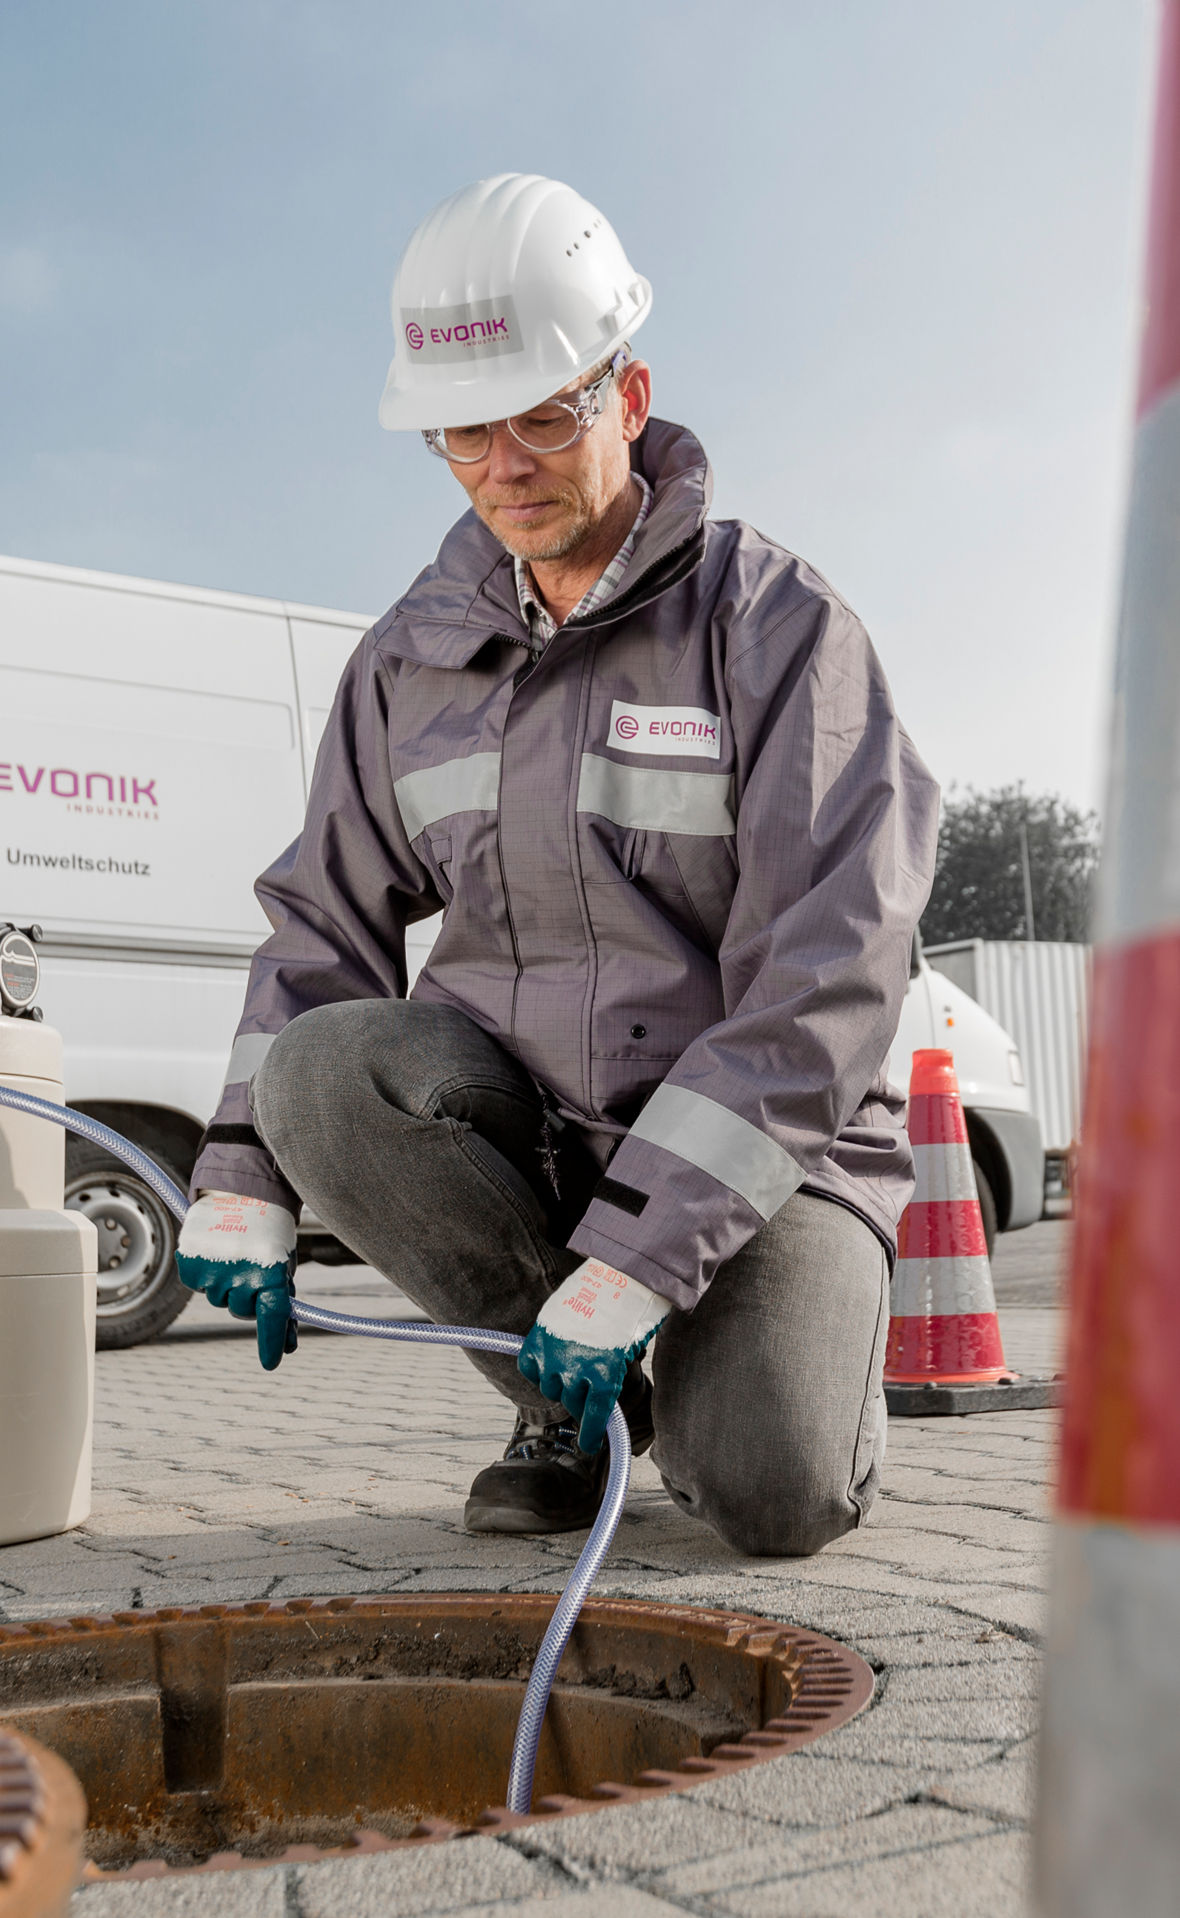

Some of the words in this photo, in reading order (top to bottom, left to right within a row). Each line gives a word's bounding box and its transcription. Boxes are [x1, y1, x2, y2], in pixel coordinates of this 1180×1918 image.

[430, 317, 508, 343] EVONIK
[648, 721, 716, 740] EVONIK
[66, 803, 160, 821] INDUSTRIES
[7, 848, 151, 877] Umweltschutz
